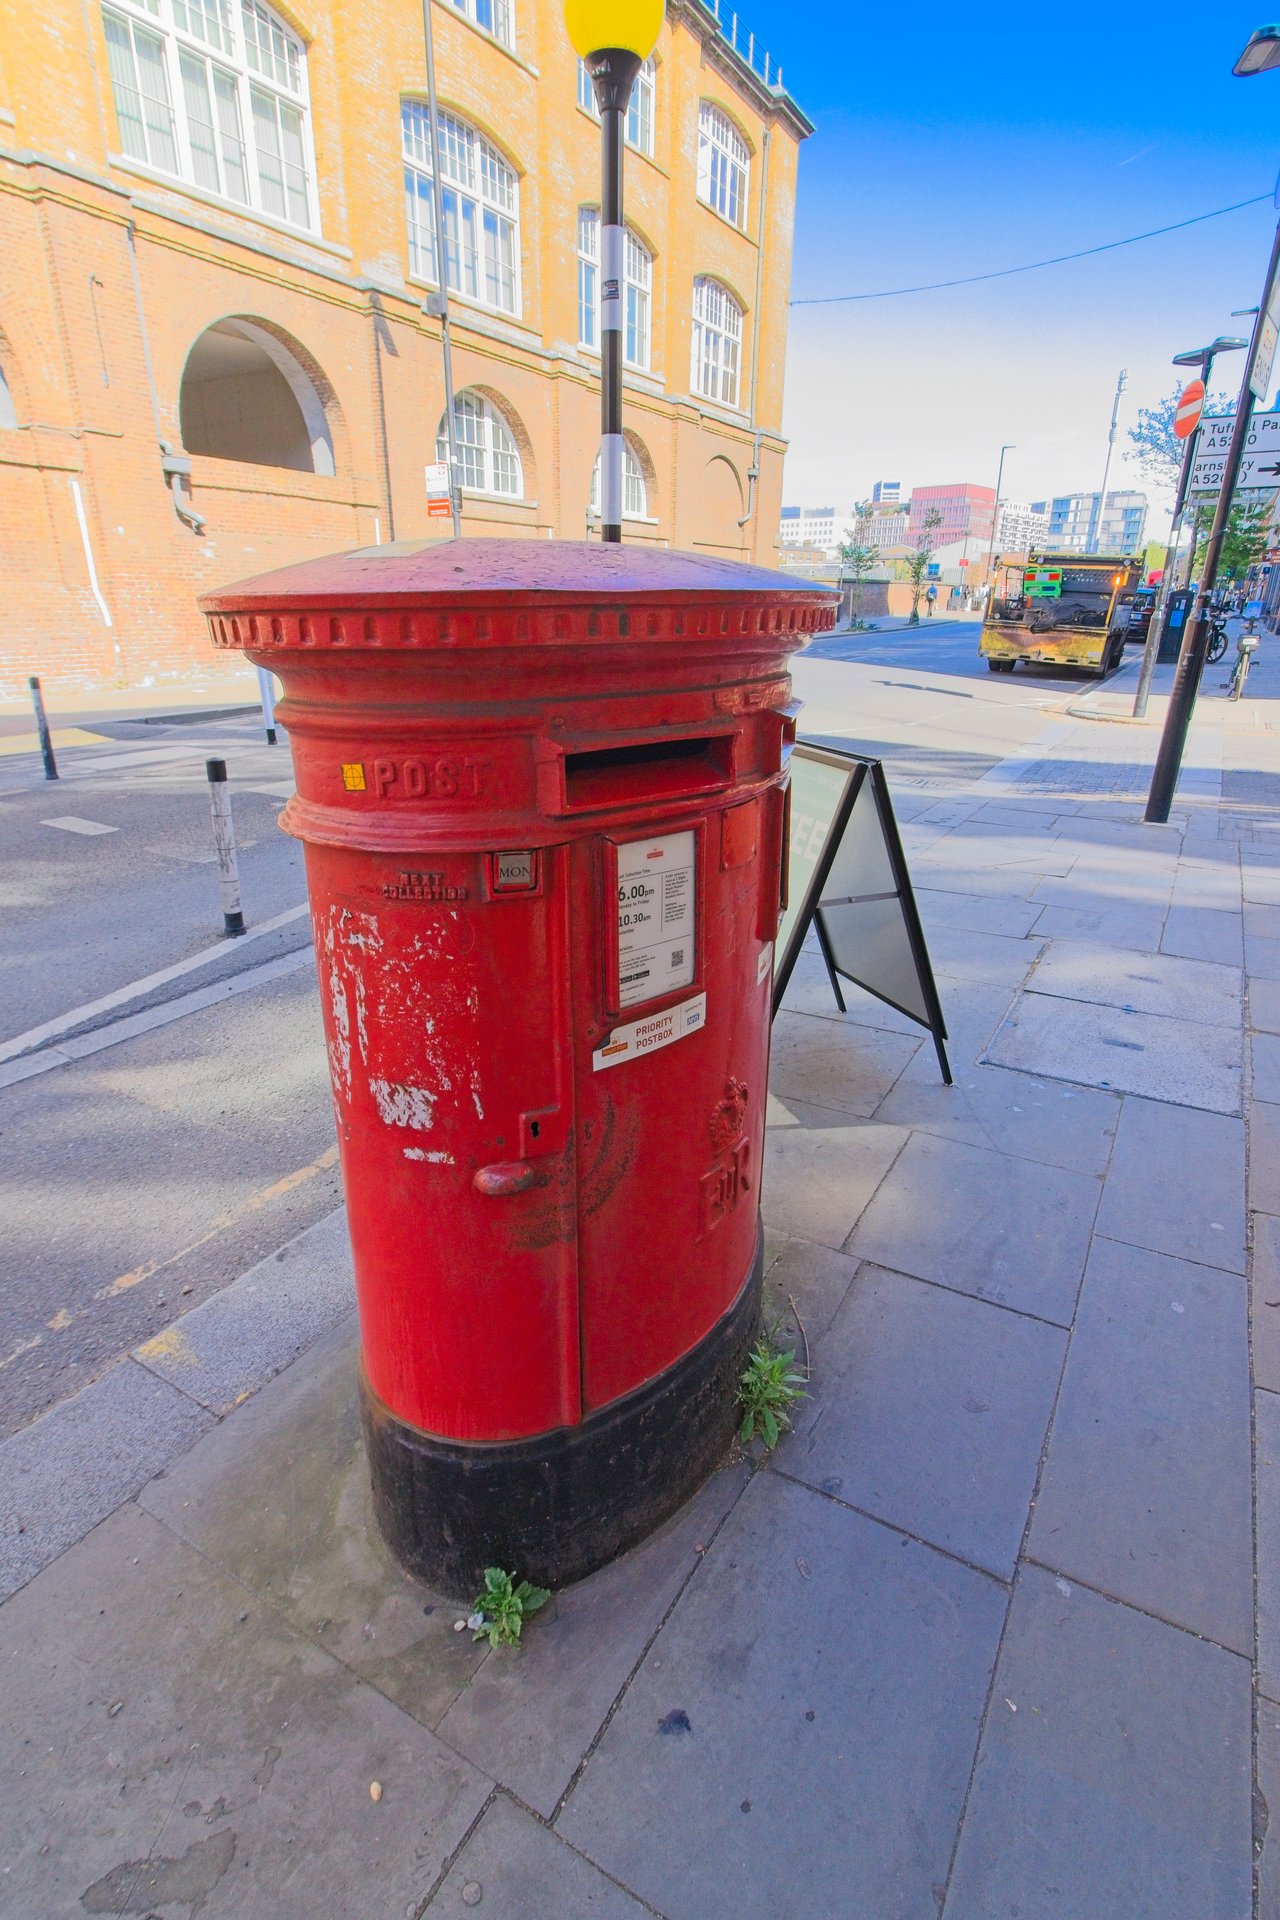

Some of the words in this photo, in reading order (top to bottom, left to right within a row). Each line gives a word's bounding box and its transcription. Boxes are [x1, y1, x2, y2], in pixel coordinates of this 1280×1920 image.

[1210, 420, 1256, 435] Tufl
[1261, 419, 1280, 431] Pa
[1195, 460, 1255, 473] arnsry
[374, 757, 490, 798] POST
[400, 872, 443, 887] NEXT
[500, 866, 530, 878] MON
[384, 885, 468, 900] COLLECTION
[618, 884, 655, 902] 6.00pm
[618, 912, 652, 928] 10.30am
[635, 1015, 674, 1038] PRIORITY
[636, 1027, 673, 1050] POSTBOX
